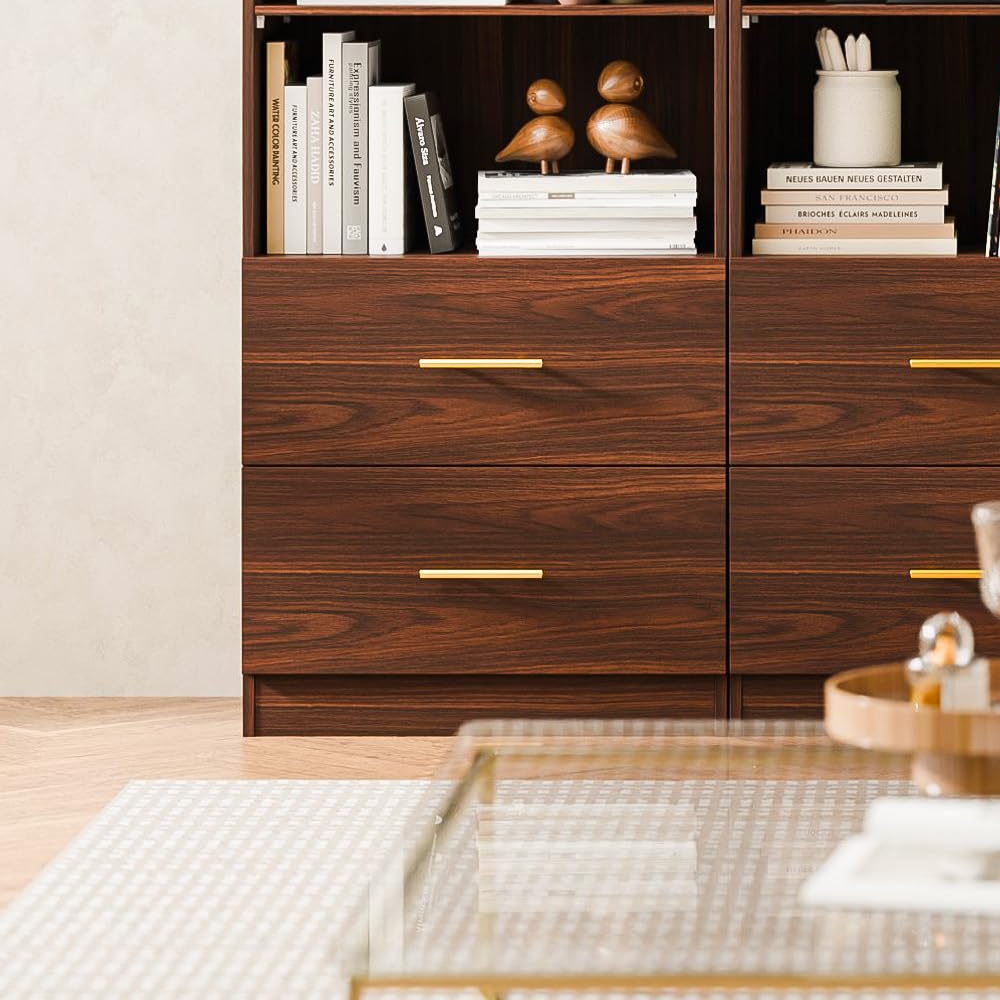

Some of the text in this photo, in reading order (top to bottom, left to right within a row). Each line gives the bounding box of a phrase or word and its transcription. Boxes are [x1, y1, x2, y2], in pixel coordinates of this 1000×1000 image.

[272, 98, 280, 186] WATER COLOR PAINTING
[353, 62, 362, 205] Expressionism and Fauvism
[786, 175, 922, 183] NEUES BAUEN NEUES GESTALTEN
